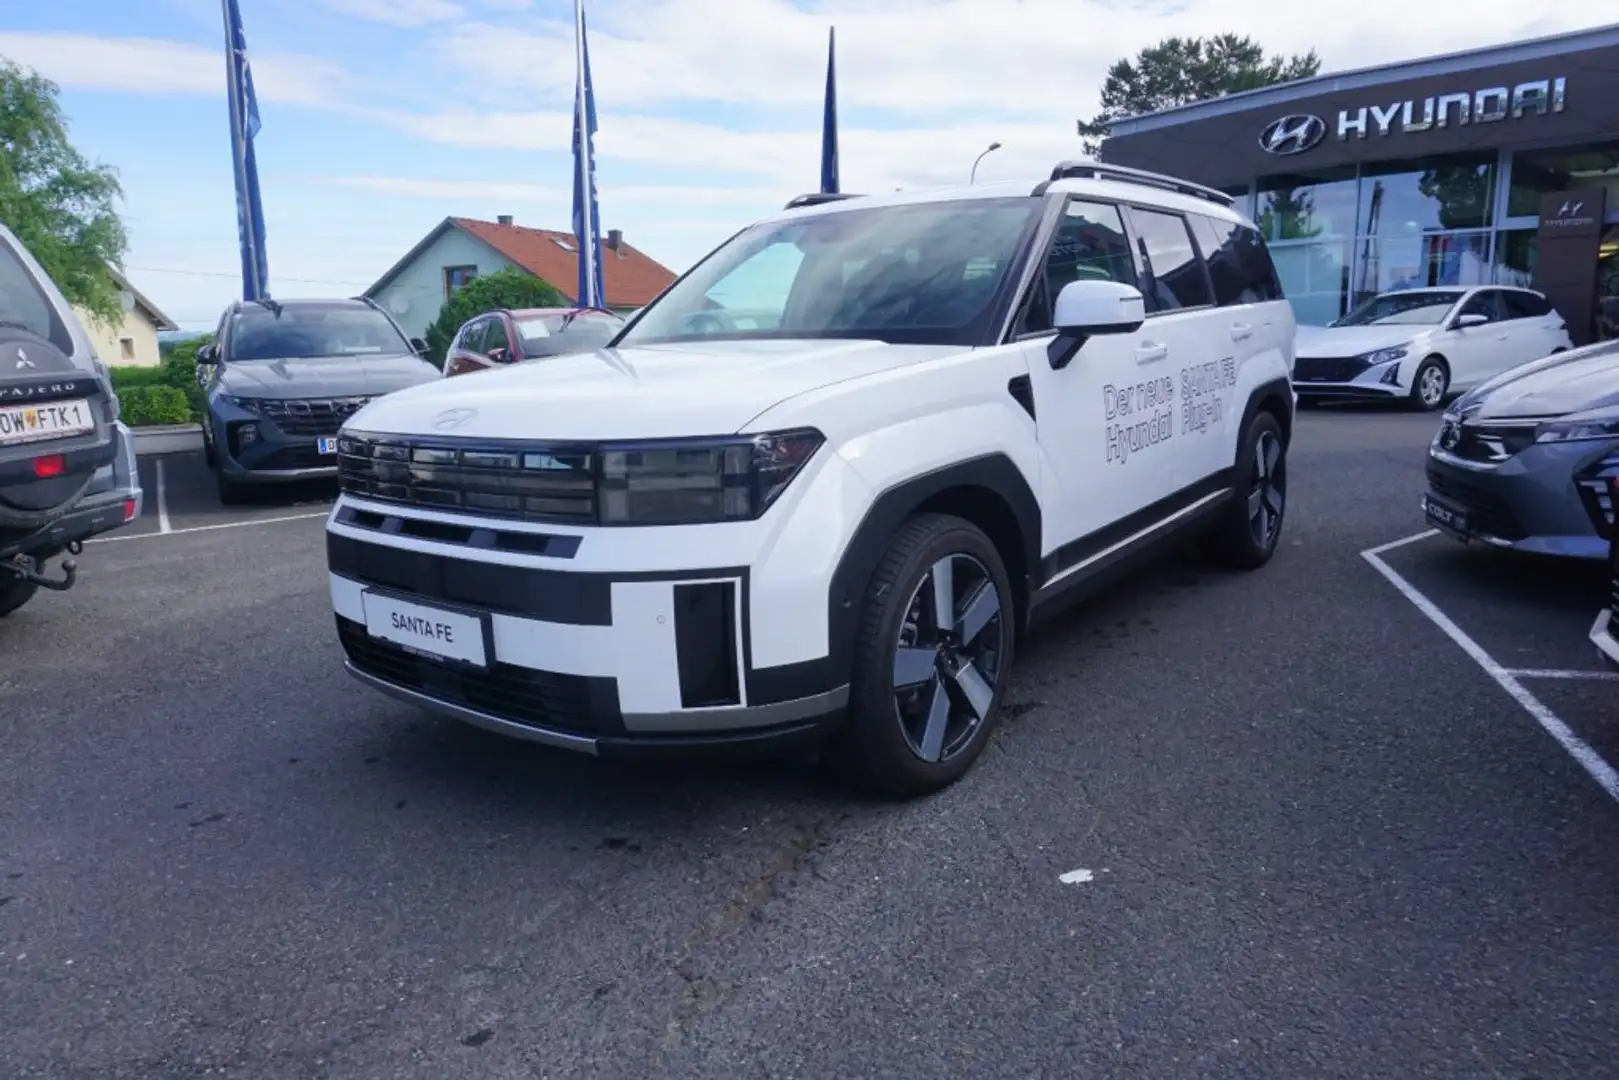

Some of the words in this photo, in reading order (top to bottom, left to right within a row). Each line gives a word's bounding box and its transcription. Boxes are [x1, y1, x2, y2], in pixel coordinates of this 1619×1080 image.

[1337, 76, 1567, 141] HYUNDAI
[0, 382, 76, 398] PAJERO
[1103, 383, 1133, 421] Der
[1136, 376, 1173, 411] neue
[1180, 360, 1221, 401] SANTA
[1106, 404, 1173, 465] Hyundai
[391, 611, 434, 639] SANTA
[435, 623, 454, 643] FE
